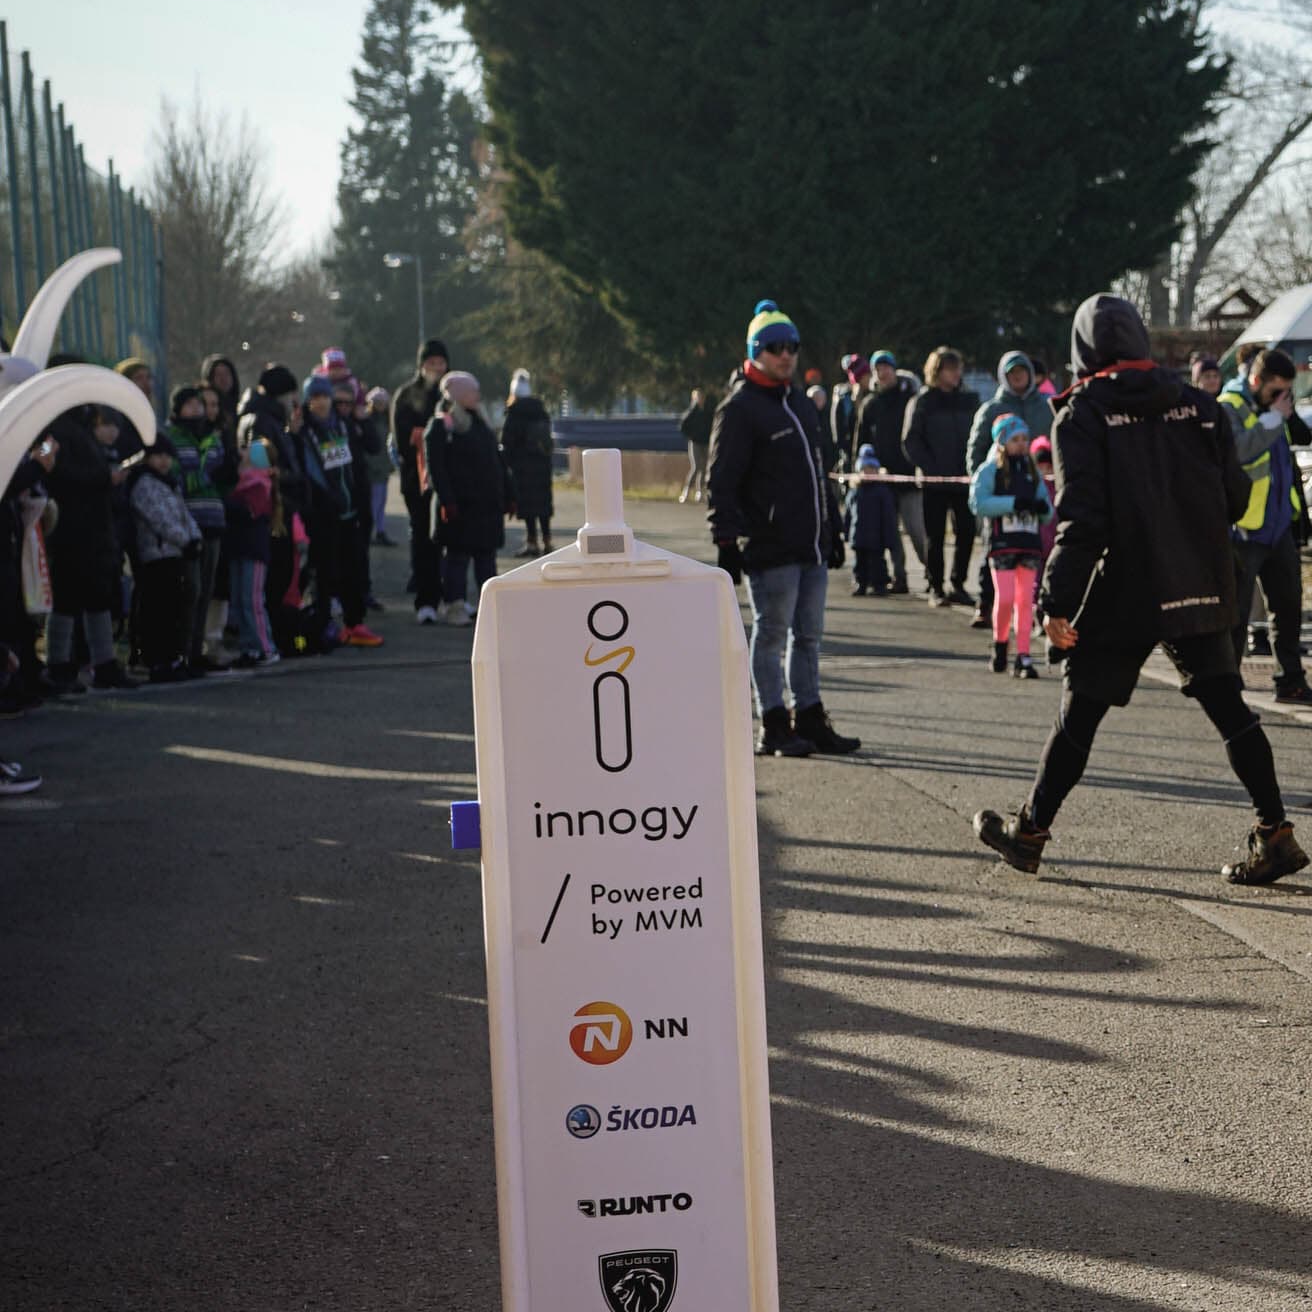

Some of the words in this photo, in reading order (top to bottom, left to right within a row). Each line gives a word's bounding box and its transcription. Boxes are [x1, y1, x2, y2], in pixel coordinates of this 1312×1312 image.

[533, 801, 699, 841] innogy
[590, 877, 703, 904] Powered
[591, 914, 624, 941] by
[635, 908, 703, 933] MVM
[644, 1016, 690, 1040] NN
[605, 1104, 698, 1132] ŠKODA
[600, 1192, 694, 1217] RUNTO
[605, 1255, 671, 1269] PEUGEOT
